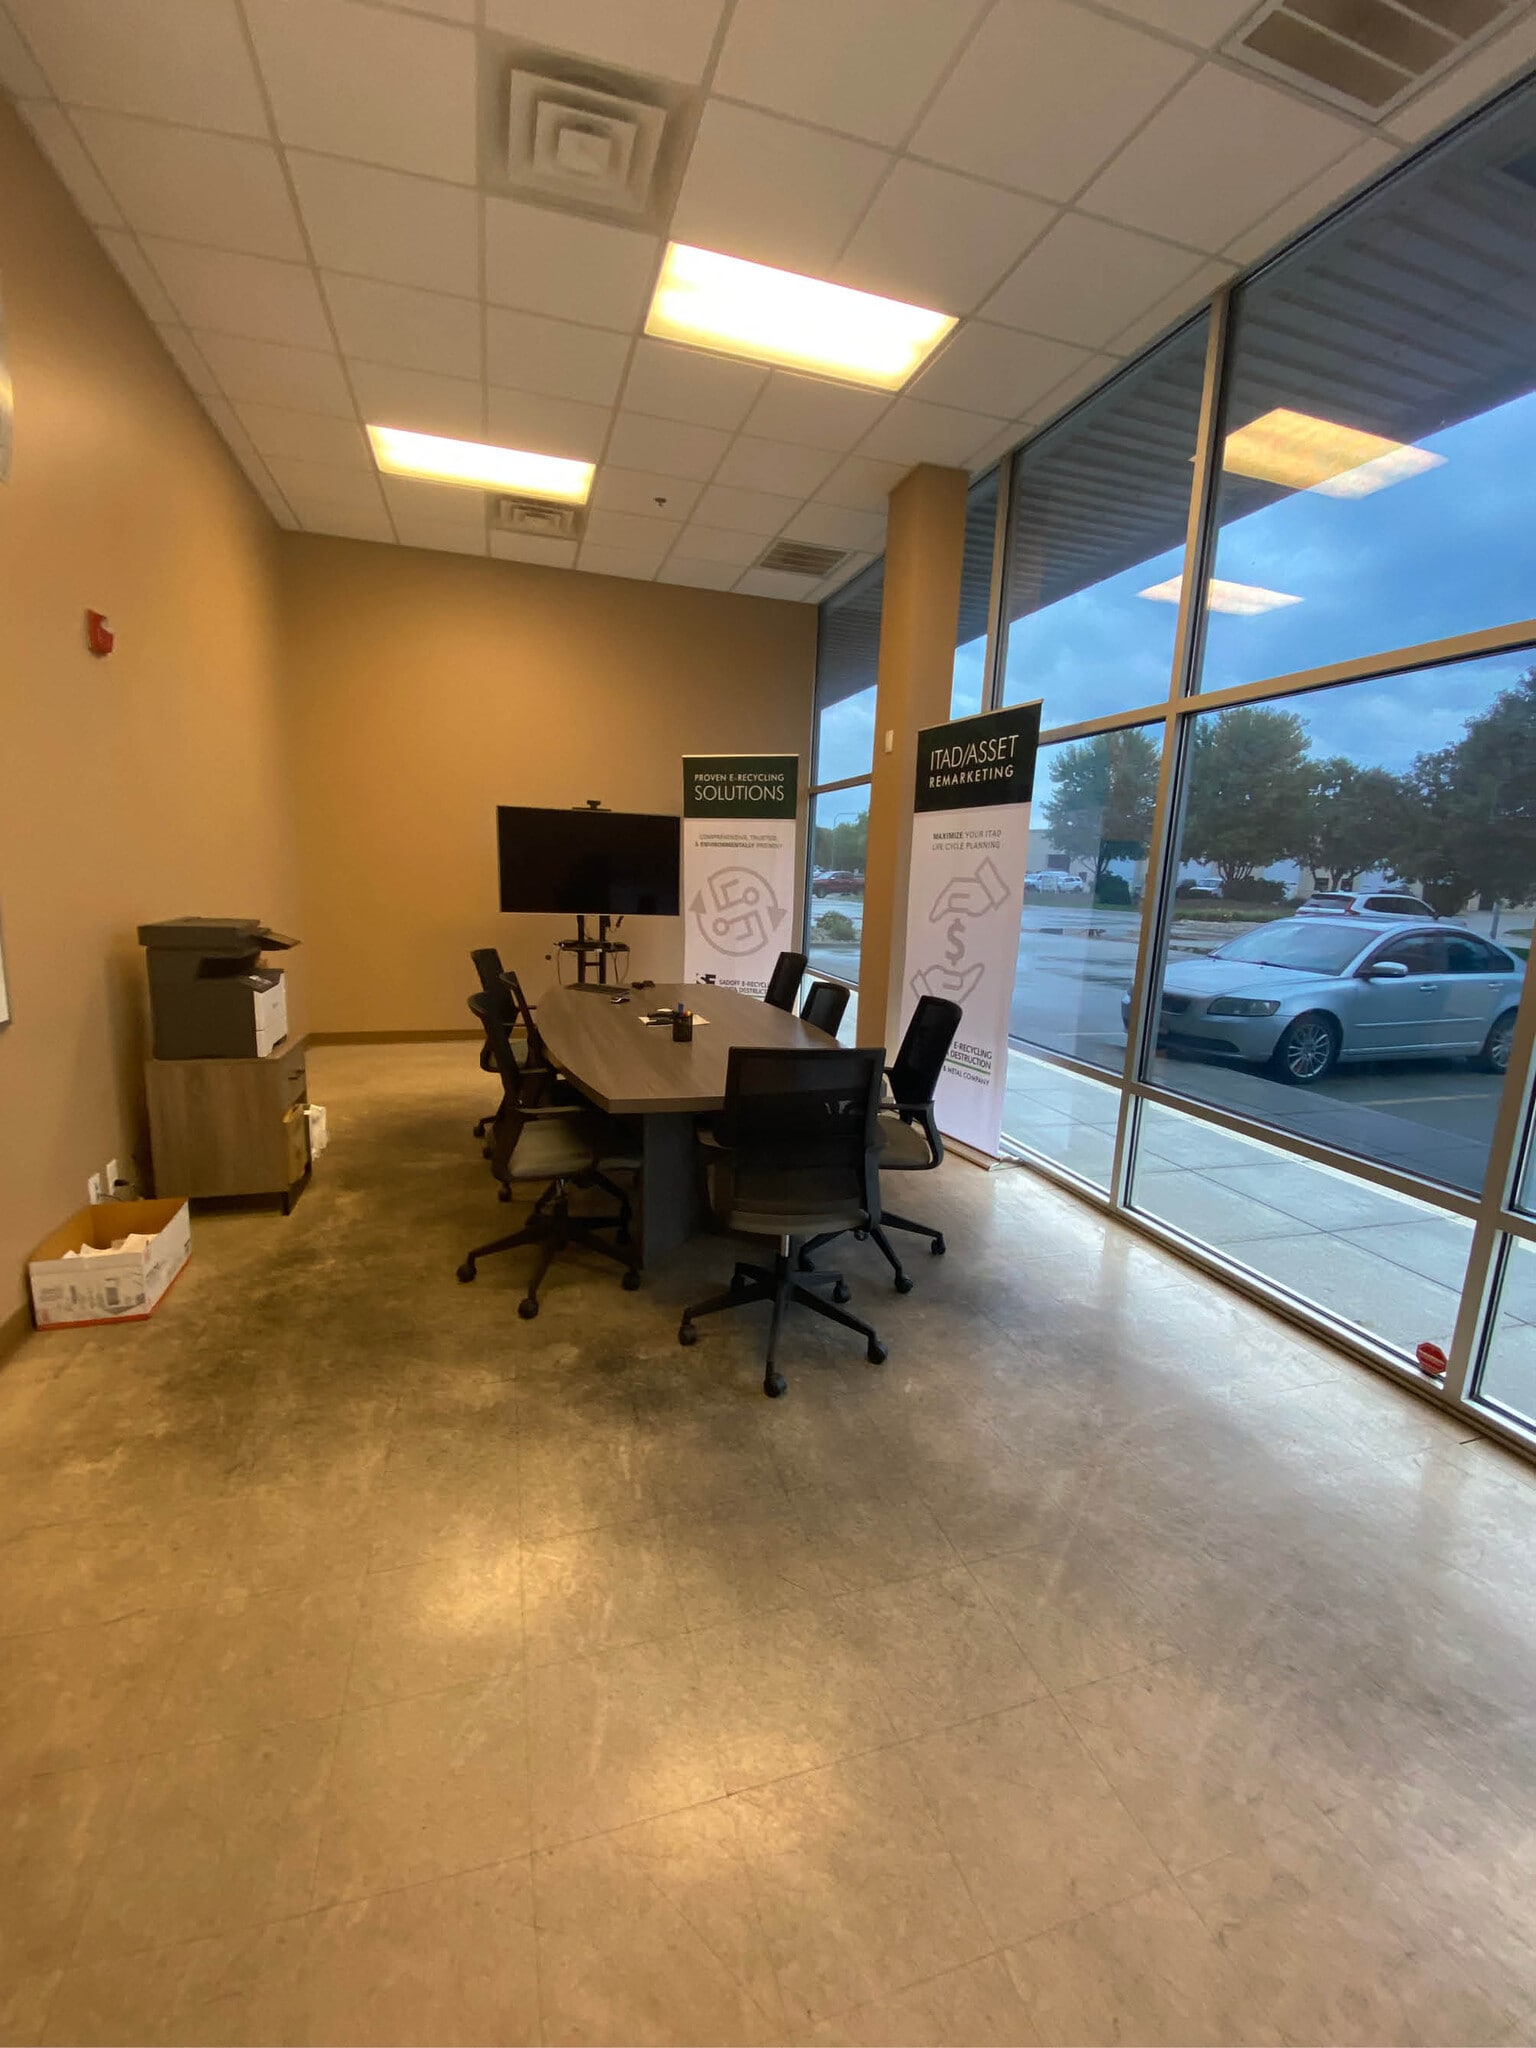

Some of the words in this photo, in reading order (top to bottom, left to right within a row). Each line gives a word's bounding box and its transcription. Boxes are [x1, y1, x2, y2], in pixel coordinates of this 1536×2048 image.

[930, 734, 1019, 771] ITAD/ASSET
[694, 773, 727, 782] PROVEN
[729, 773, 785, 782] E-RECYCLING
[929, 764, 1014, 788] REMARKETING
[694, 785, 785, 801] SOLUTIONS
[933, 831, 963, 840] MAXIMIZE
[965, 830, 983, 839] YOUR
[985, 829, 1002, 838] ITAD
[932, 843, 944, 851] LIFE
[945, 843, 963, 851] CYCLE
[966, 841, 1001, 850] PLANNING
[741, 980, 768, 988] E-RECYCL
[953, 1041, 992, 1060] E-RECYCLING
[950, 1050, 991, 1070] DESTRUCTION
[947, 1067, 962, 1078] METAL
[963, 1071, 989, 1086] COMPANY
